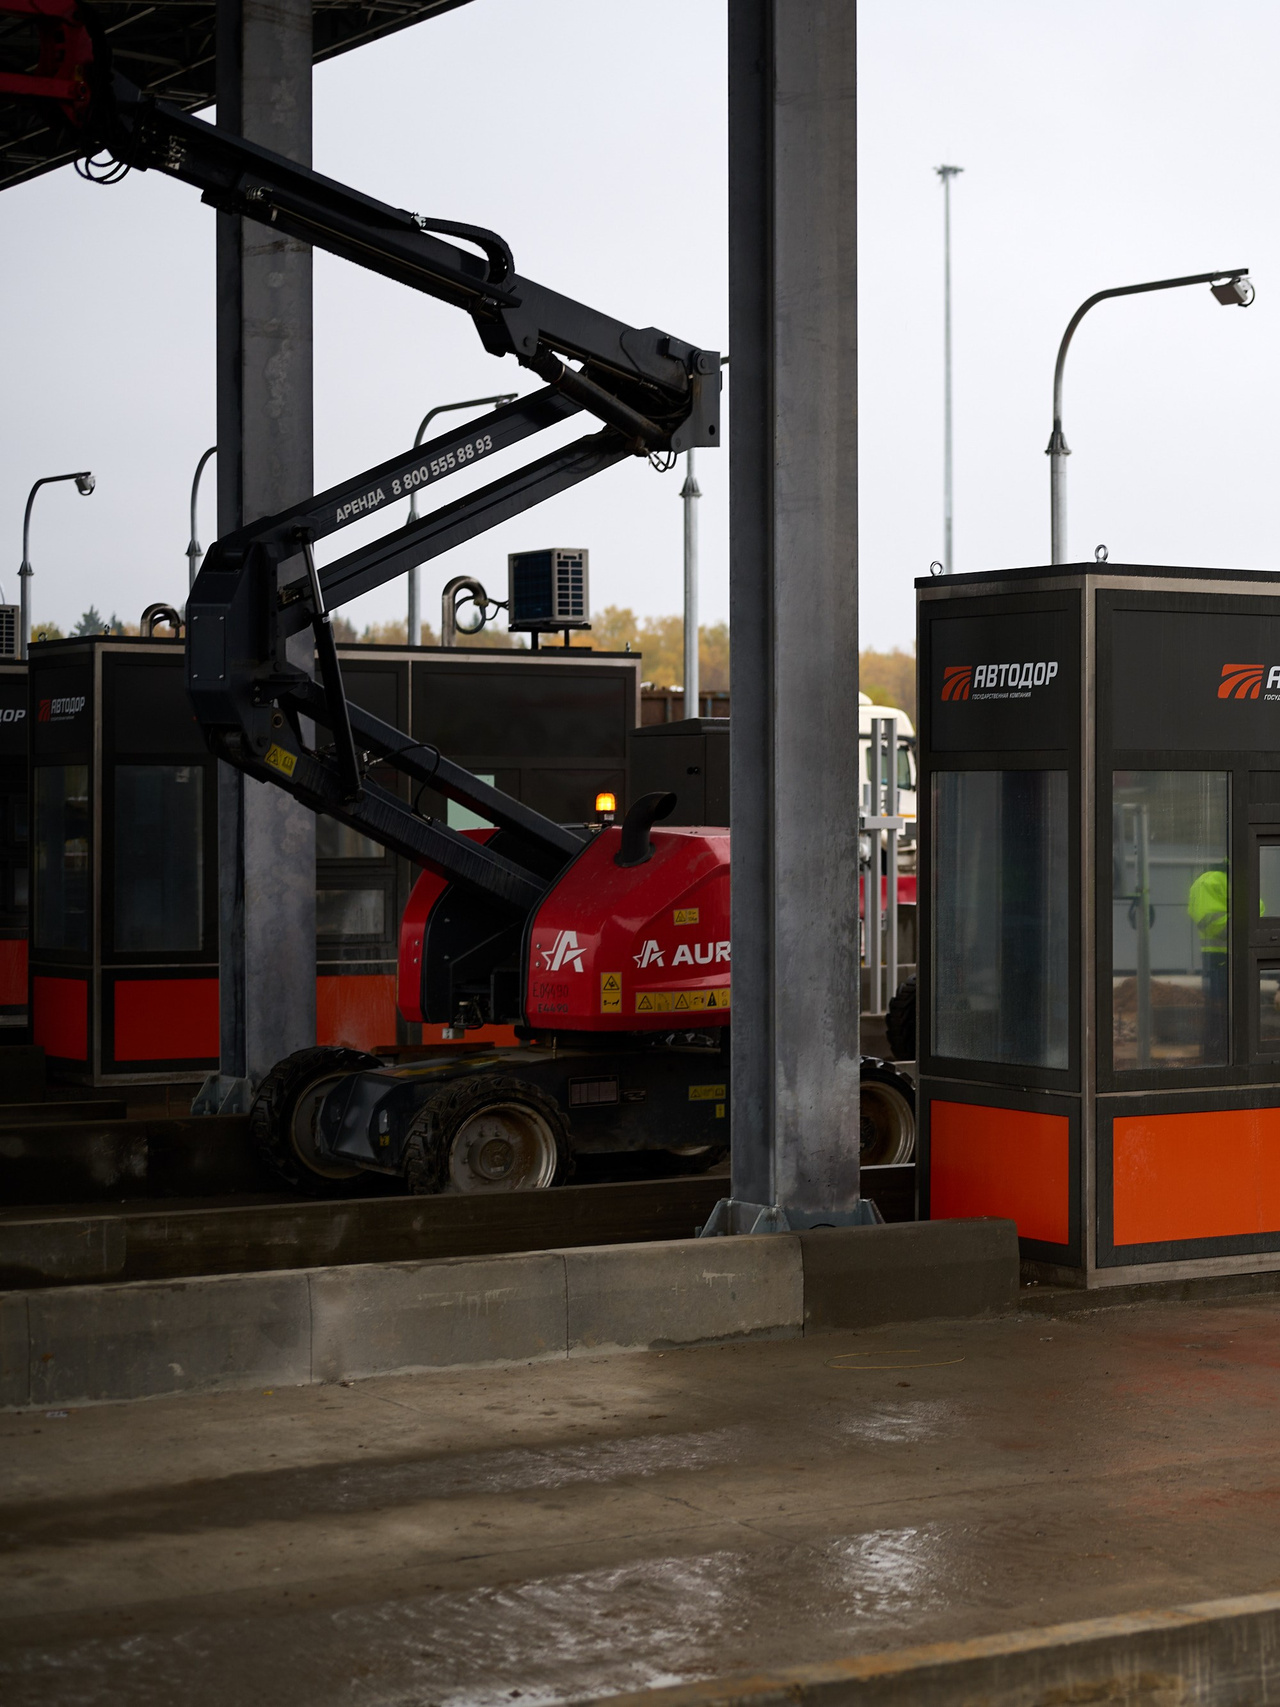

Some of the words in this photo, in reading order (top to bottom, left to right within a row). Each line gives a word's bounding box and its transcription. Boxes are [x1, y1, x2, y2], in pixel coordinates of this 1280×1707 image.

[336, 488, 386, 523] АРЕНДА
[391, 479, 402, 495] 8
[403, 466, 429, 490] 800
[430, 452, 456, 476] 555
[456, 443, 475, 463] 88
[475, 434, 493, 454] 93
[973, 661, 1059, 689] АВТОДОР
[0, 709, 26, 723] ОР
[51, 696, 86, 714] АВТОДОР
[671, 941, 731, 966] AUR
